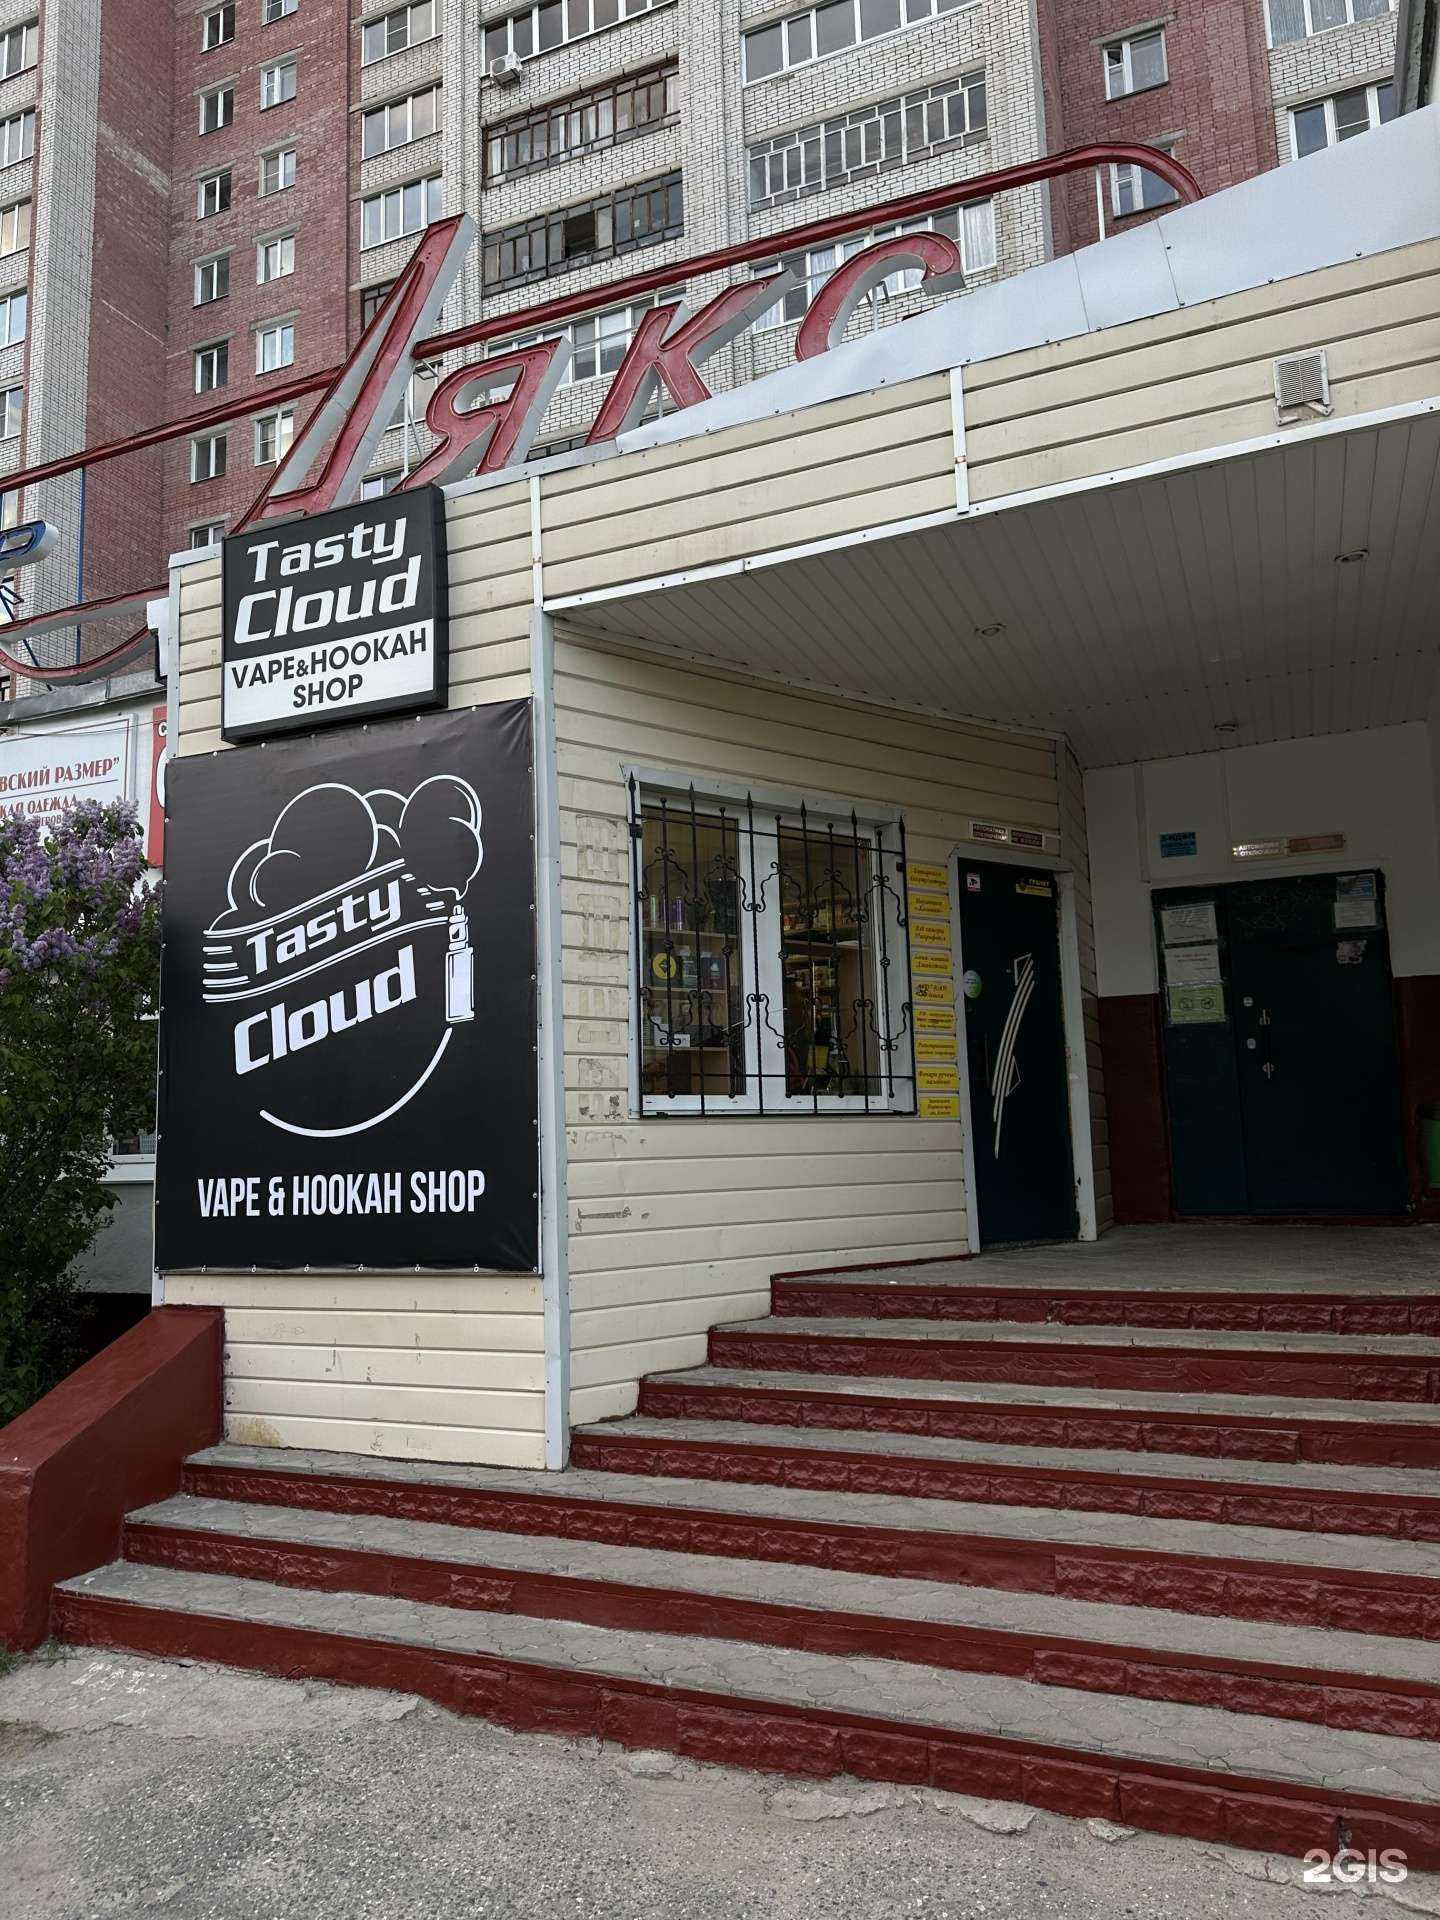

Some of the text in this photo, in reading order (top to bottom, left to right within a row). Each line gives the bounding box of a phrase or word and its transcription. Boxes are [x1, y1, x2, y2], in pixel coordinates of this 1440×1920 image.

[246, 516, 407, 583] Tasty
[233, 554, 422, 645] Cloud
[231, 627, 427, 689] VAPE&HOOKAH
[292, 673, 364, 708] SHOP
[246, 878, 402, 976] Tasty
[233, 944, 418, 1076] Cloud
[198, 1169, 486, 1219] VAPE & HOOKAH SHOP
